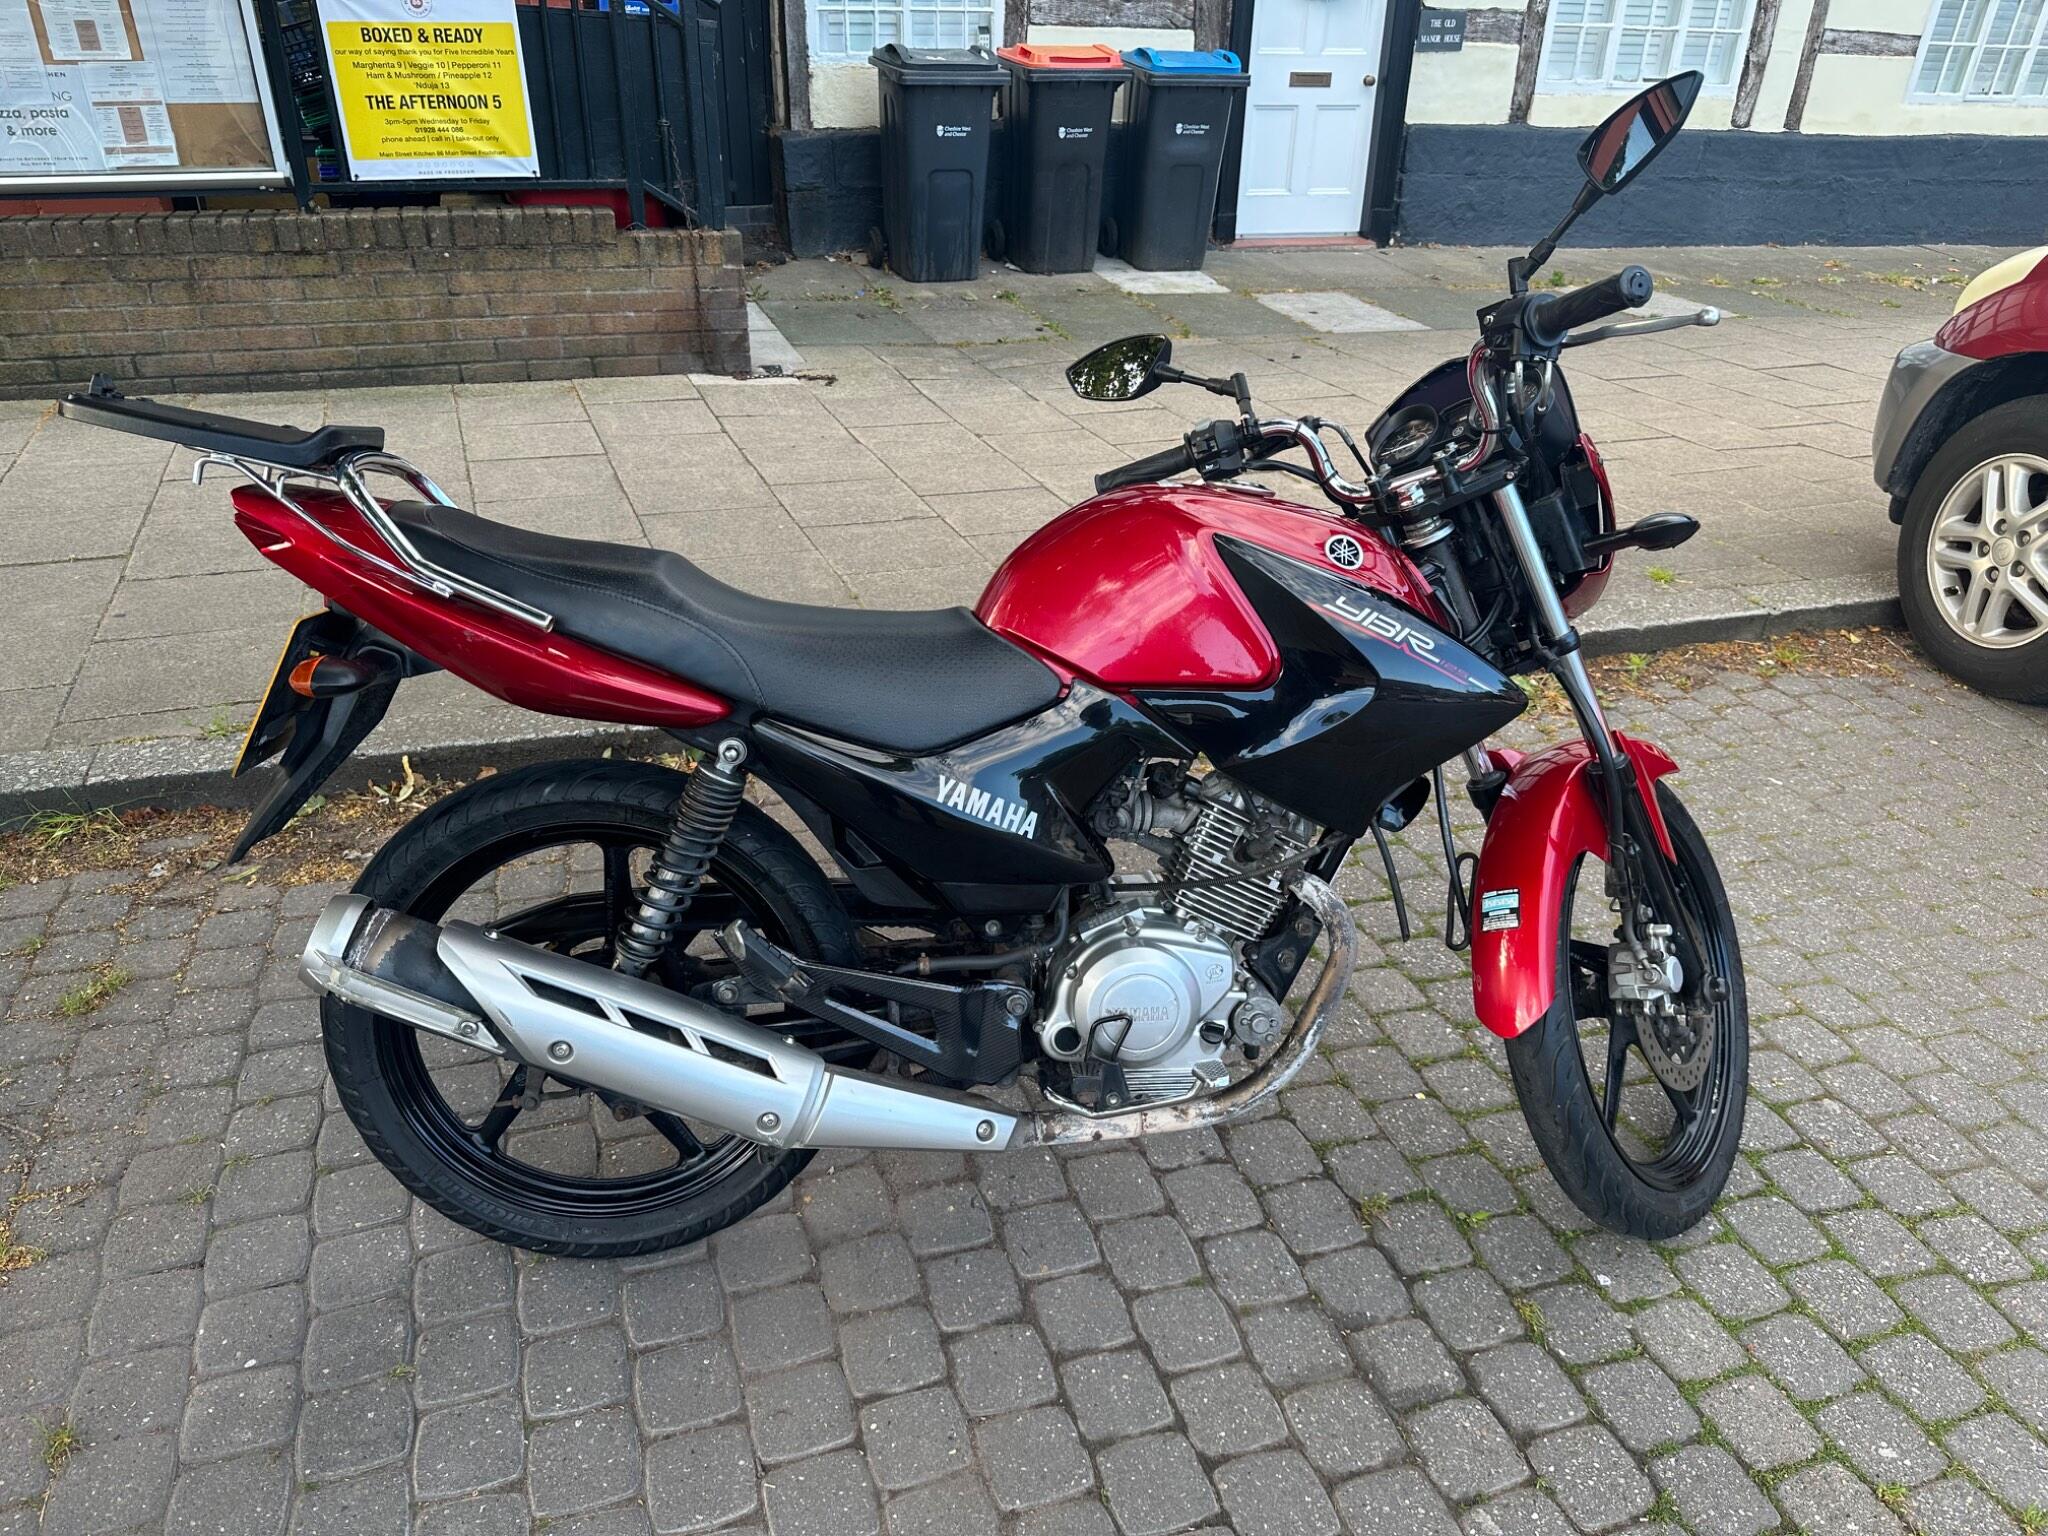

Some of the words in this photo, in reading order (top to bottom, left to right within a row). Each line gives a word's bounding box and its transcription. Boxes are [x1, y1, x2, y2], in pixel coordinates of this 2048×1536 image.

[1430, 18, 1442, 28] THE
[1444, 18, 1457, 28] OLD
[360, 27, 413, 43] BOXED
[417, 28, 430, 43] &
[433, 28, 483, 43] READY
[1421, 34, 1441, 43] MANOR
[1443, 34, 1462, 43] HOUSE
[374, 48, 396, 56] saying
[352, 61, 395, 70] Margherita
[396, 61, 402, 69] 9
[408, 61, 434, 70] Veggie
[451, 61, 491, 70] Pepperoni
[492, 61, 501, 69] 11
[443, 72, 481, 80] Pineapple
[440, 81, 450, 89] 13
[364, 94, 396, 110] THE
[400, 94, 489, 110] AFTERNOON
[493, 94, 502, 110] 5
[30, 107, 69, 120] pasta
[419, 117, 459, 125] Wednesday
[469, 117, 490, 125] Friday
[6, 125, 16, 136] &
[21, 127, 57, 136] more
[381, 136, 404, 144] phone
[1323, 595, 1440, 663] YBR
[936, 774, 1038, 839] YAMAHA
